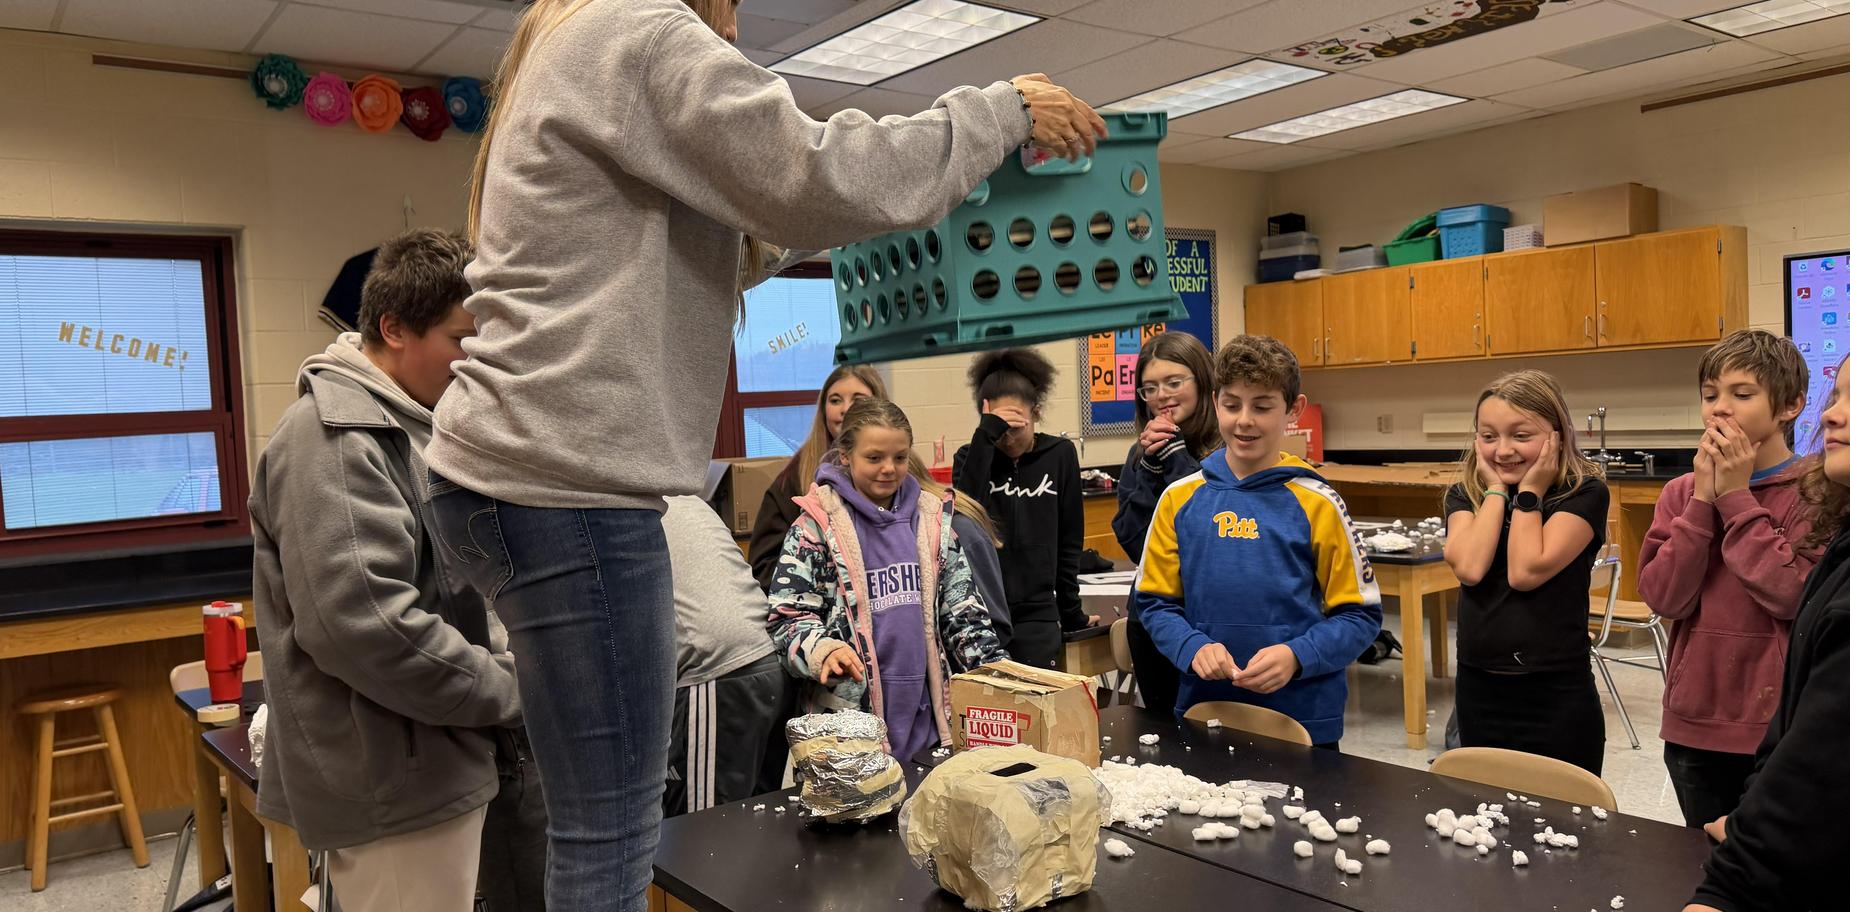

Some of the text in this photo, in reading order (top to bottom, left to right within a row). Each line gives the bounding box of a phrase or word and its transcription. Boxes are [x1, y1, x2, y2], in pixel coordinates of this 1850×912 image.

[1190, 241, 1199, 257] A
[58, 321, 188, 372] WELCOME!
[768, 322, 809, 354] SMILE!
[1091, 365, 1113, 386] Pa
[1213, 511, 1258, 539] Pitt
[969, 709, 1013, 722] FRAGILE
[969, 720, 1013, 739] LIQUID
